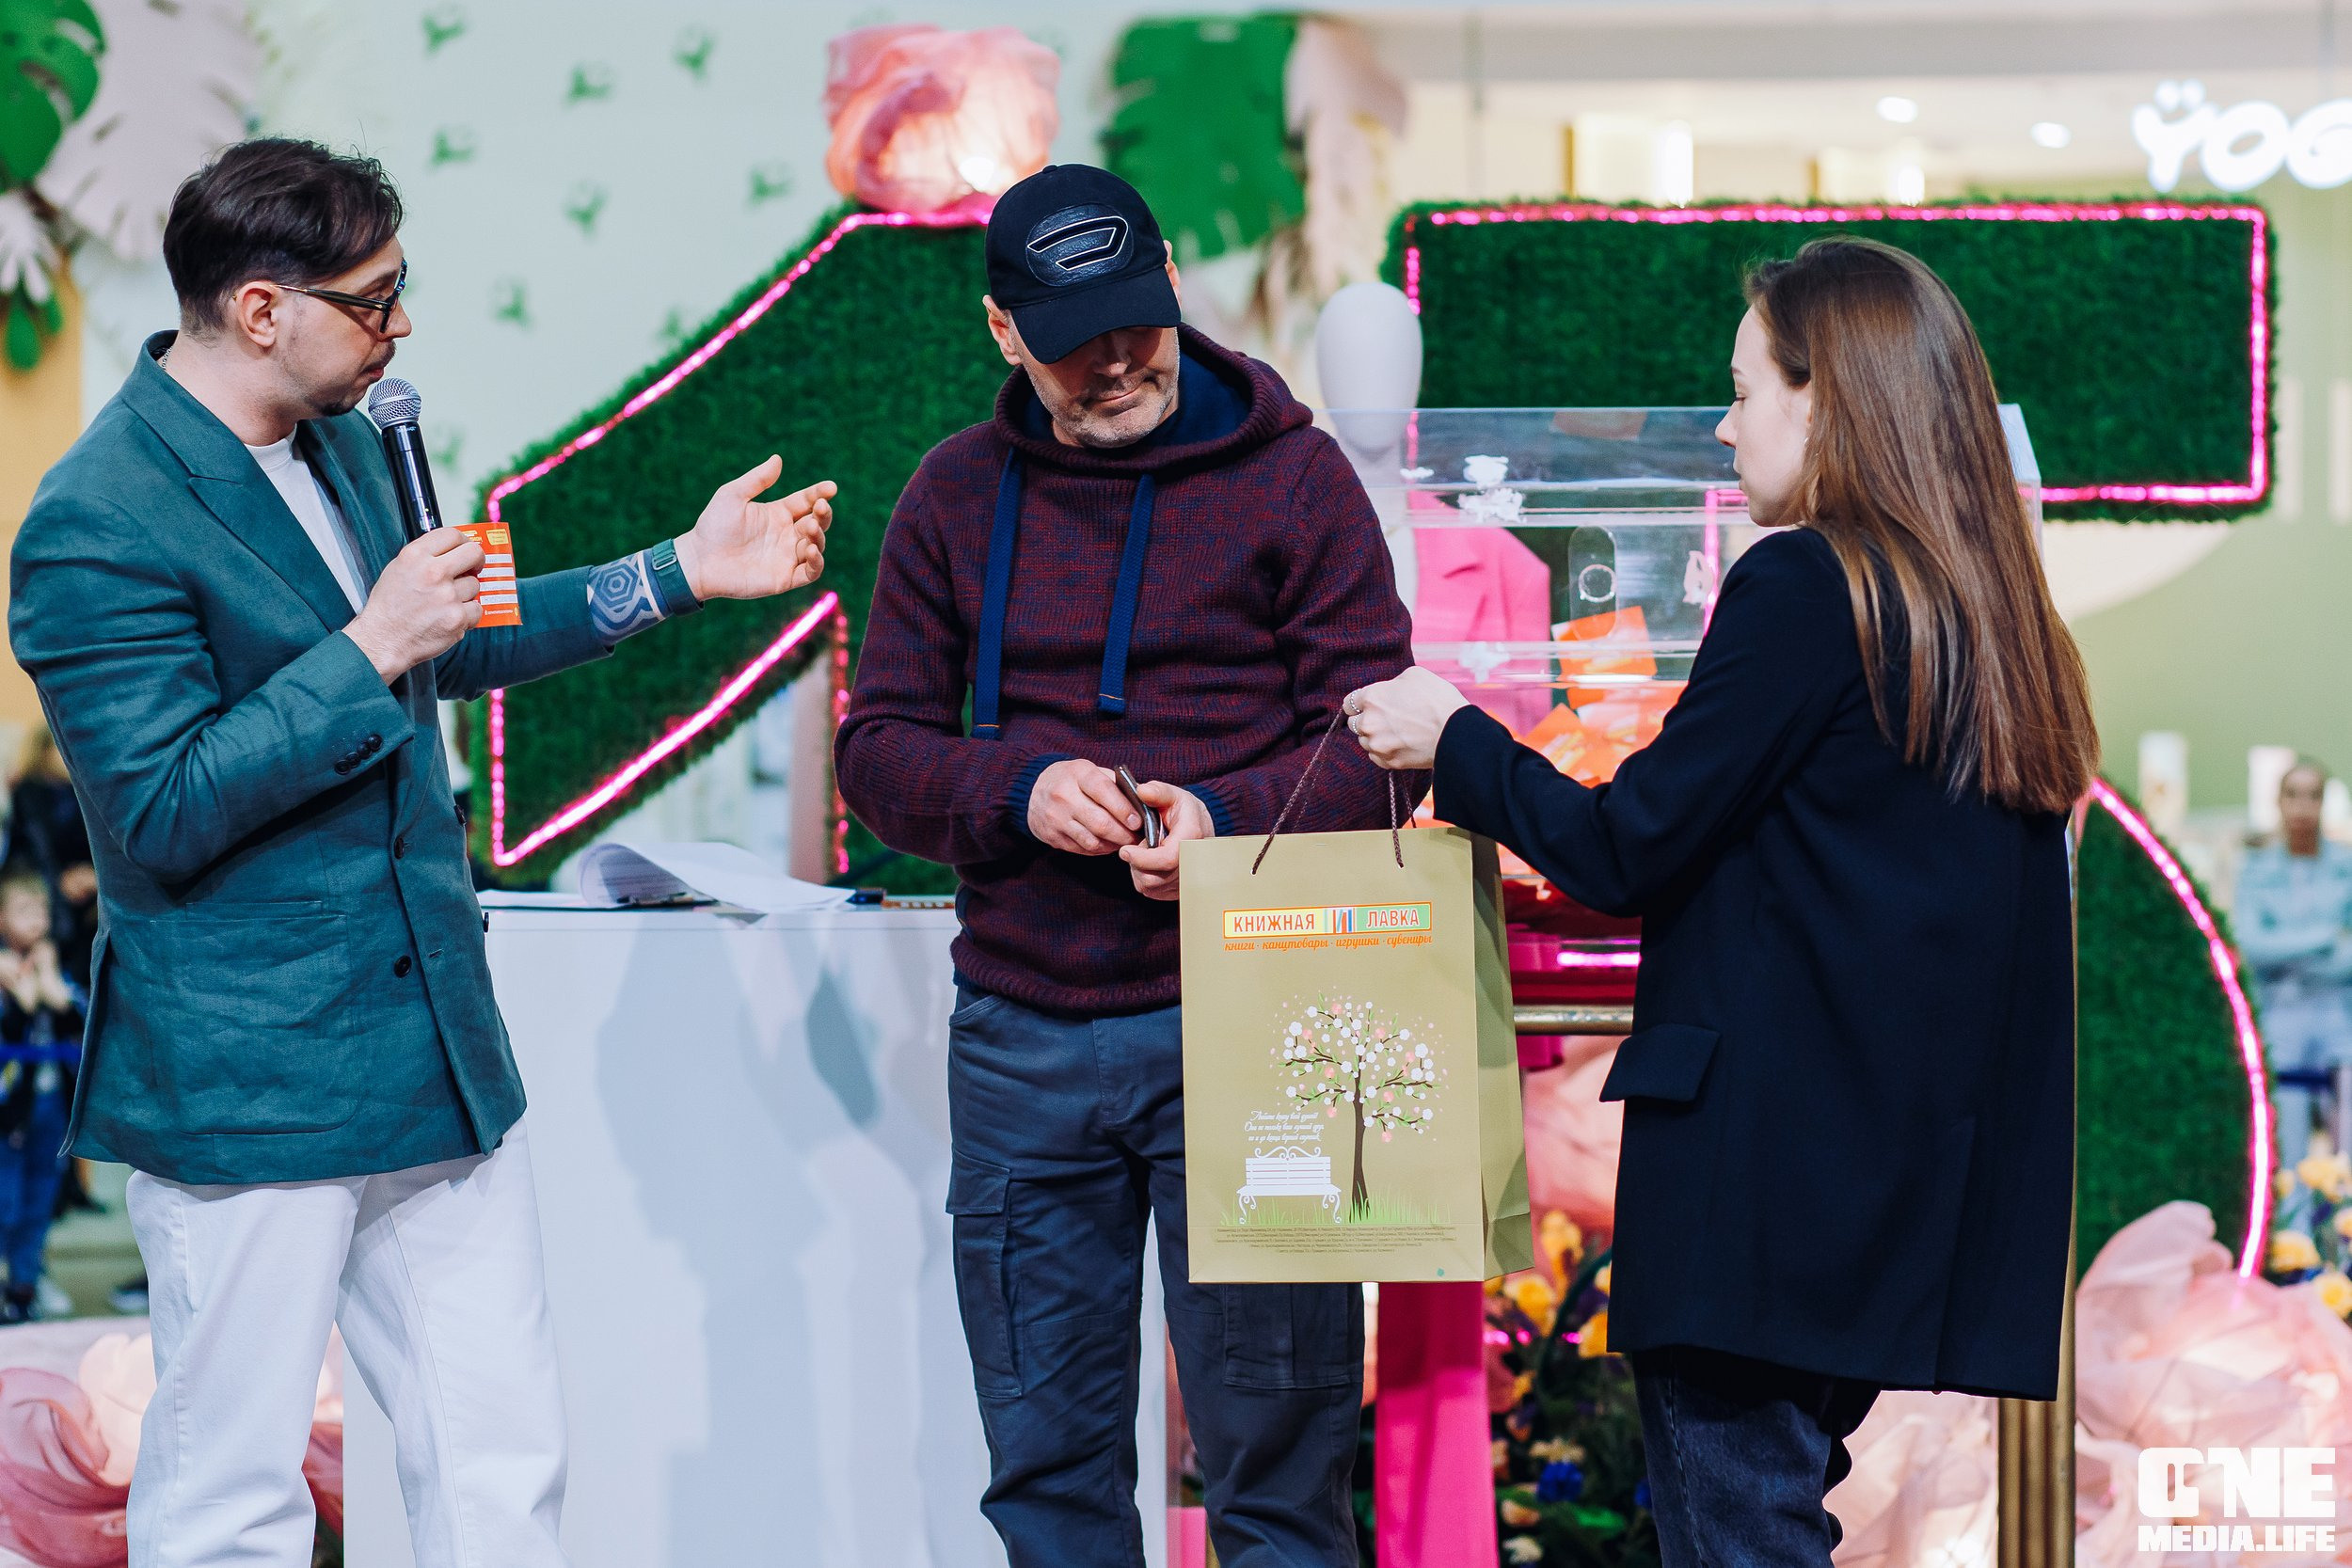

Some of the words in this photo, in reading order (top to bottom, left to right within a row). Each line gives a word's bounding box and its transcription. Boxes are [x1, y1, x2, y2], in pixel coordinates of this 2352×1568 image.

[1233, 913, 1315, 933] КНИЖНАЯ
[1367, 909, 1420, 927] ЛАВКА
[1224, 942, 1255, 951] книги
[1262, 937, 1329, 952] канцтовары
[1335, 937, 1380, 950] игрушки
[1386, 933, 1433, 949] сувениры
